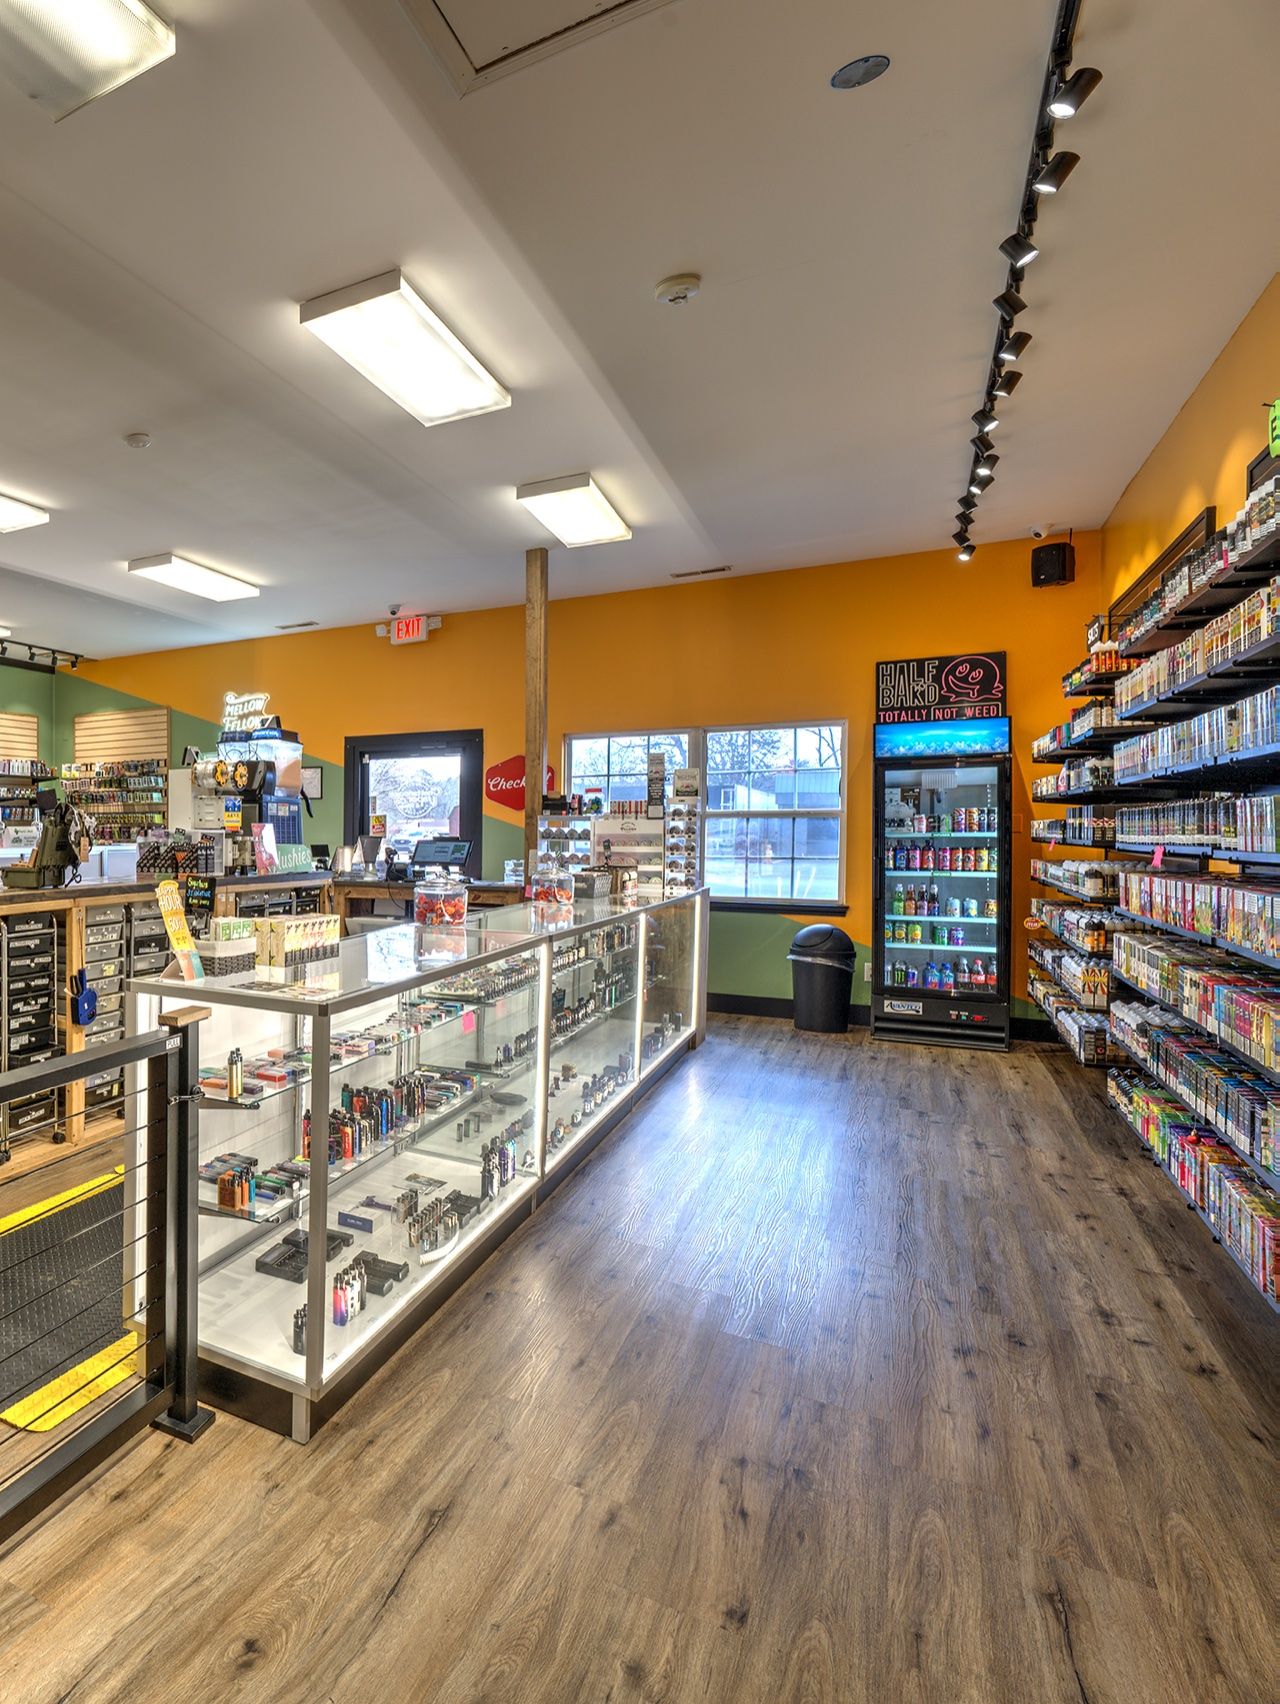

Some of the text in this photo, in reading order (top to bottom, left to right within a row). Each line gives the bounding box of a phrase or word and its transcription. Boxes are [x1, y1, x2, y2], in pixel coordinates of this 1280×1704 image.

[396, 617, 422, 640] EXIT
[879, 660, 938, 688] HALF
[225, 698, 266, 717] MELLOW
[878, 704, 998, 723] TOTALLY NOT WEED
[276, 850, 312, 873] lushies
[160, 894, 184, 912] HOUR
[166, 1038, 180, 1049] PULL
